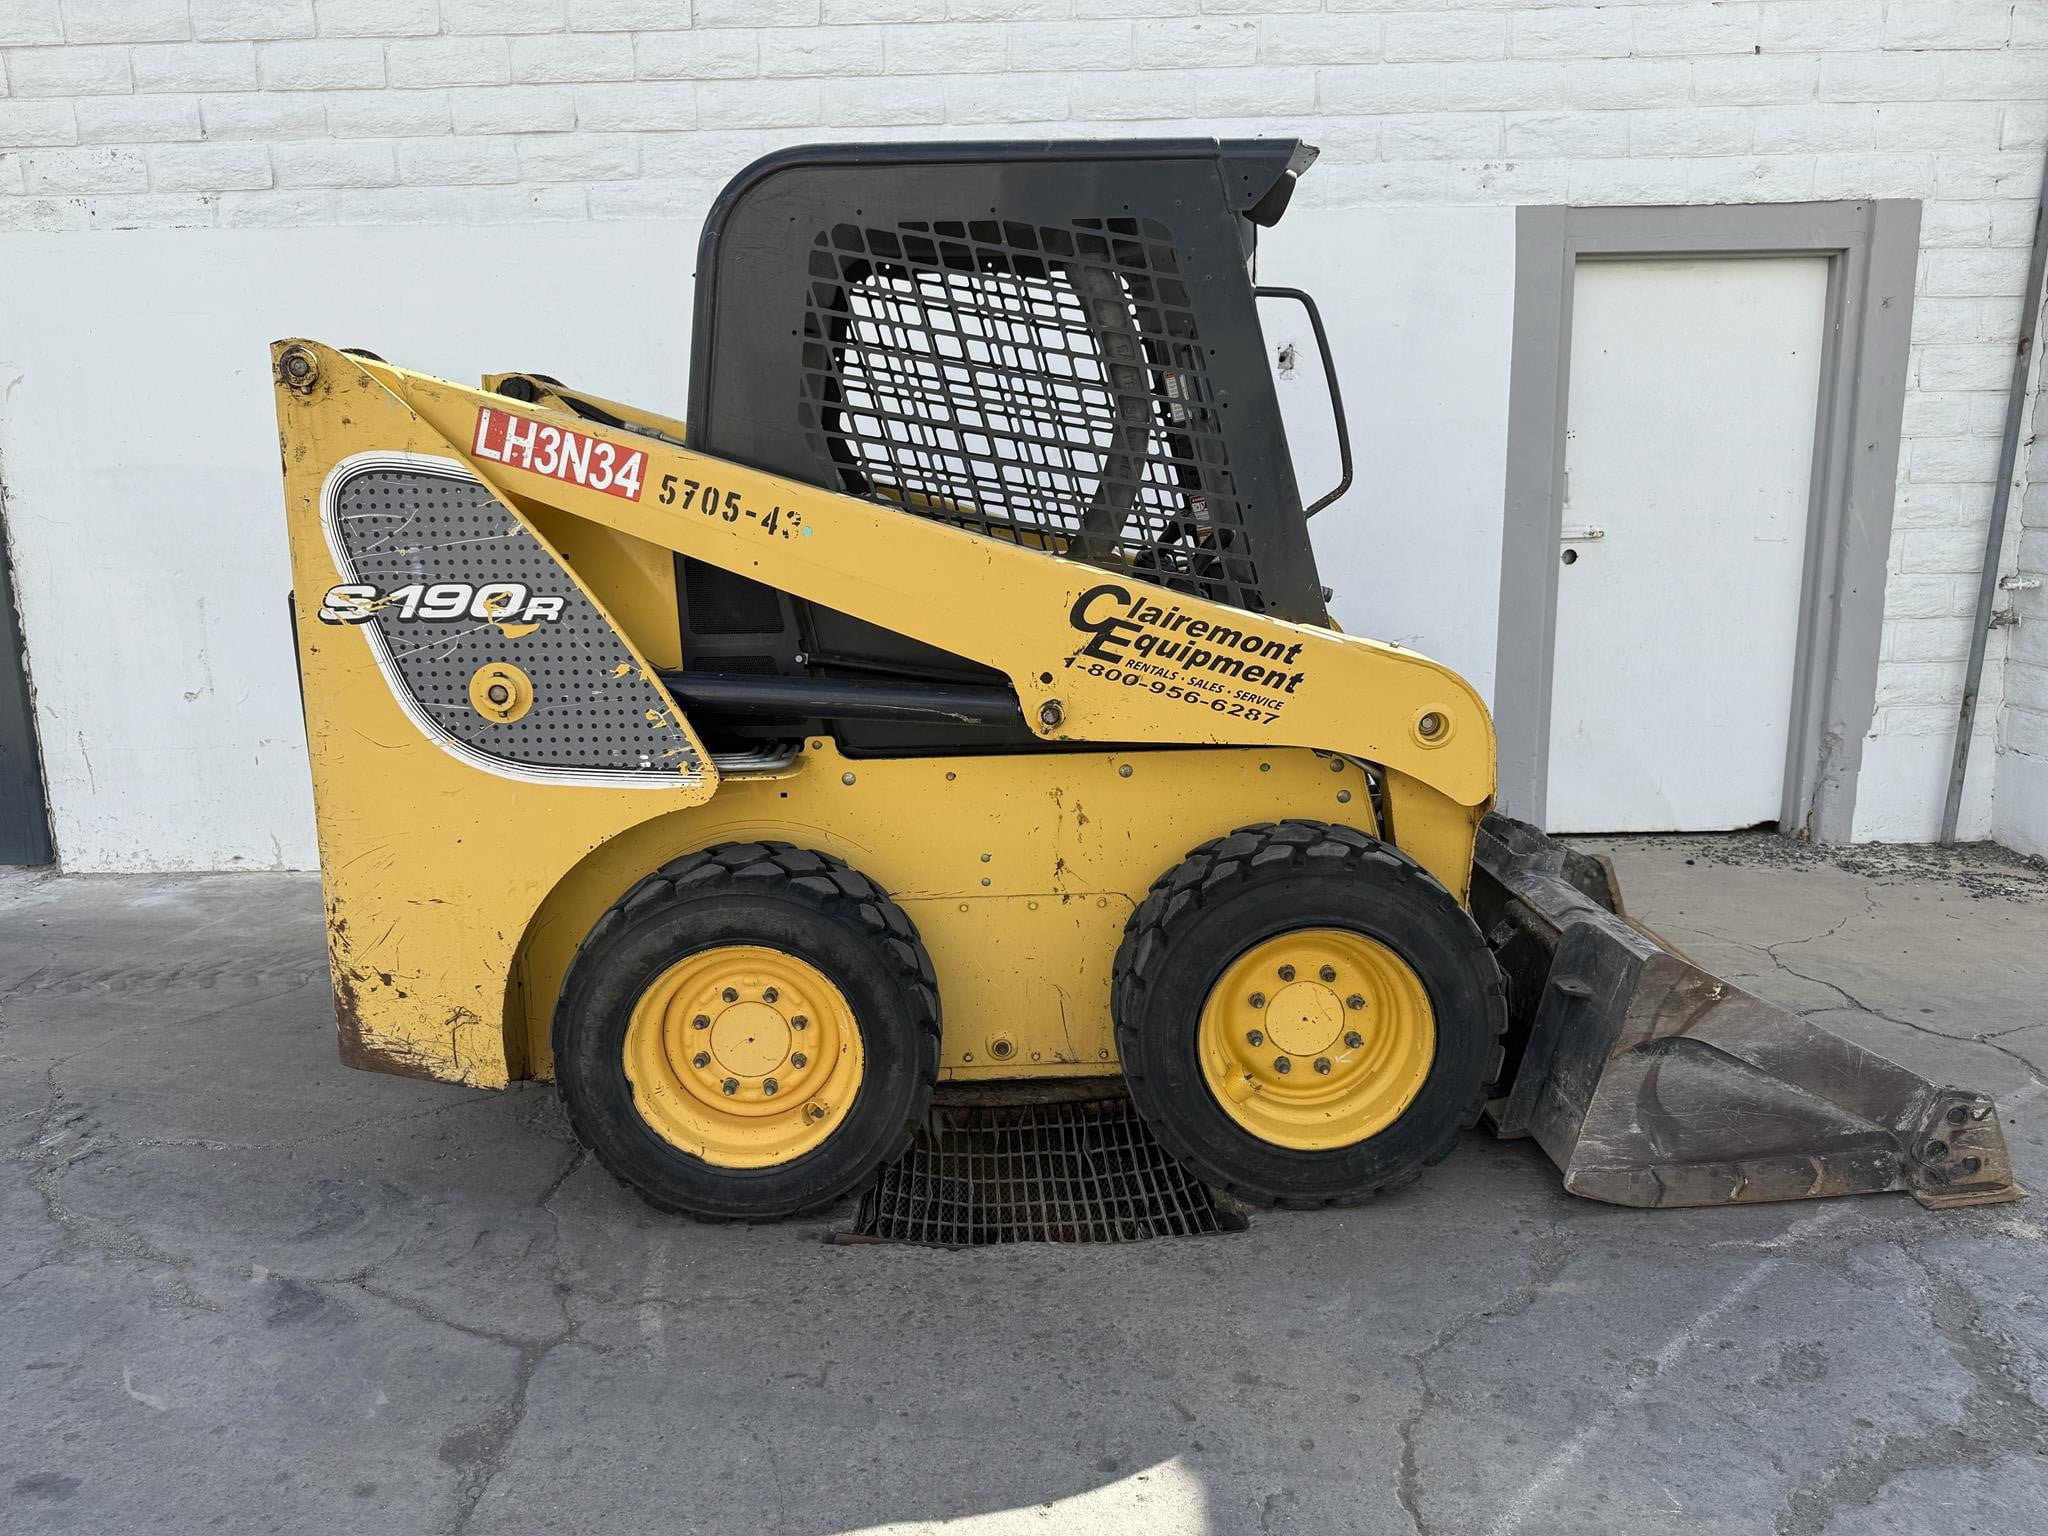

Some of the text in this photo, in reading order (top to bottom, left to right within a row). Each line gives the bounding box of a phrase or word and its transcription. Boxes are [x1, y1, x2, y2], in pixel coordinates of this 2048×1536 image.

[475, 408, 642, 498] LH3N34
[1069, 584, 1305, 665] Clairemont
[1082, 616, 1305, 694] Equipment
[1063, 657, 1281, 725] 1-800-956-6287
[1125, 658, 1285, 711] RENTALS SALES SERVICE
